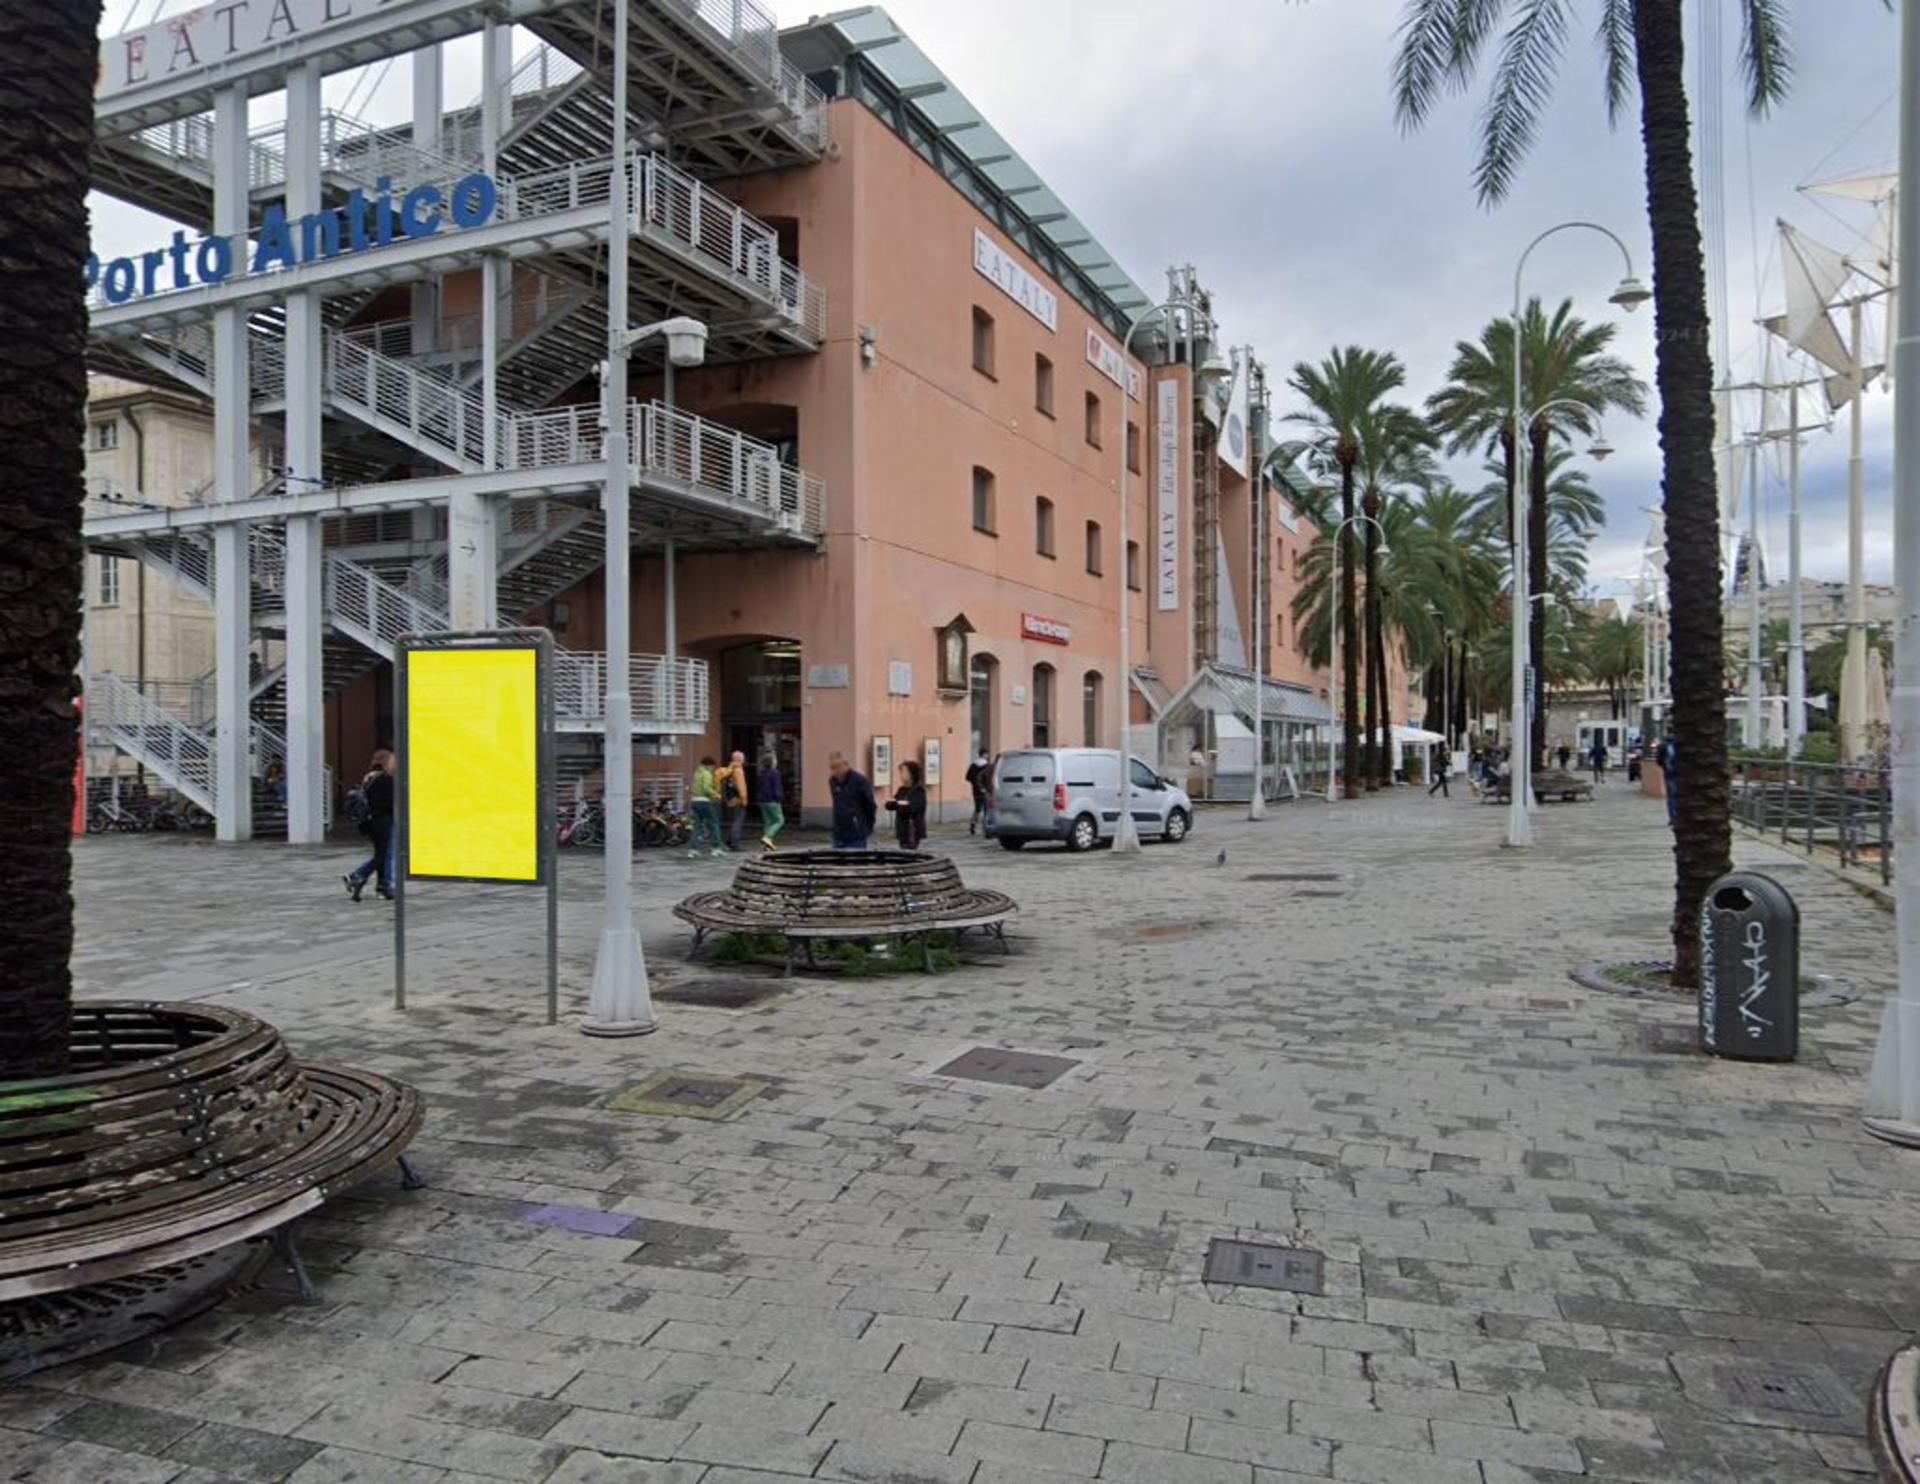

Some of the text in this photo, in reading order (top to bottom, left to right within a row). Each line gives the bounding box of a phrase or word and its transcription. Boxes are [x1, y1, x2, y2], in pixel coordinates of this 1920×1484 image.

[123, 0, 394, 86] EATAL
[250, 172, 497, 273] Antico
[976, 236, 1054, 324] EATALY
[1162, 511, 1175, 595] EATALY
